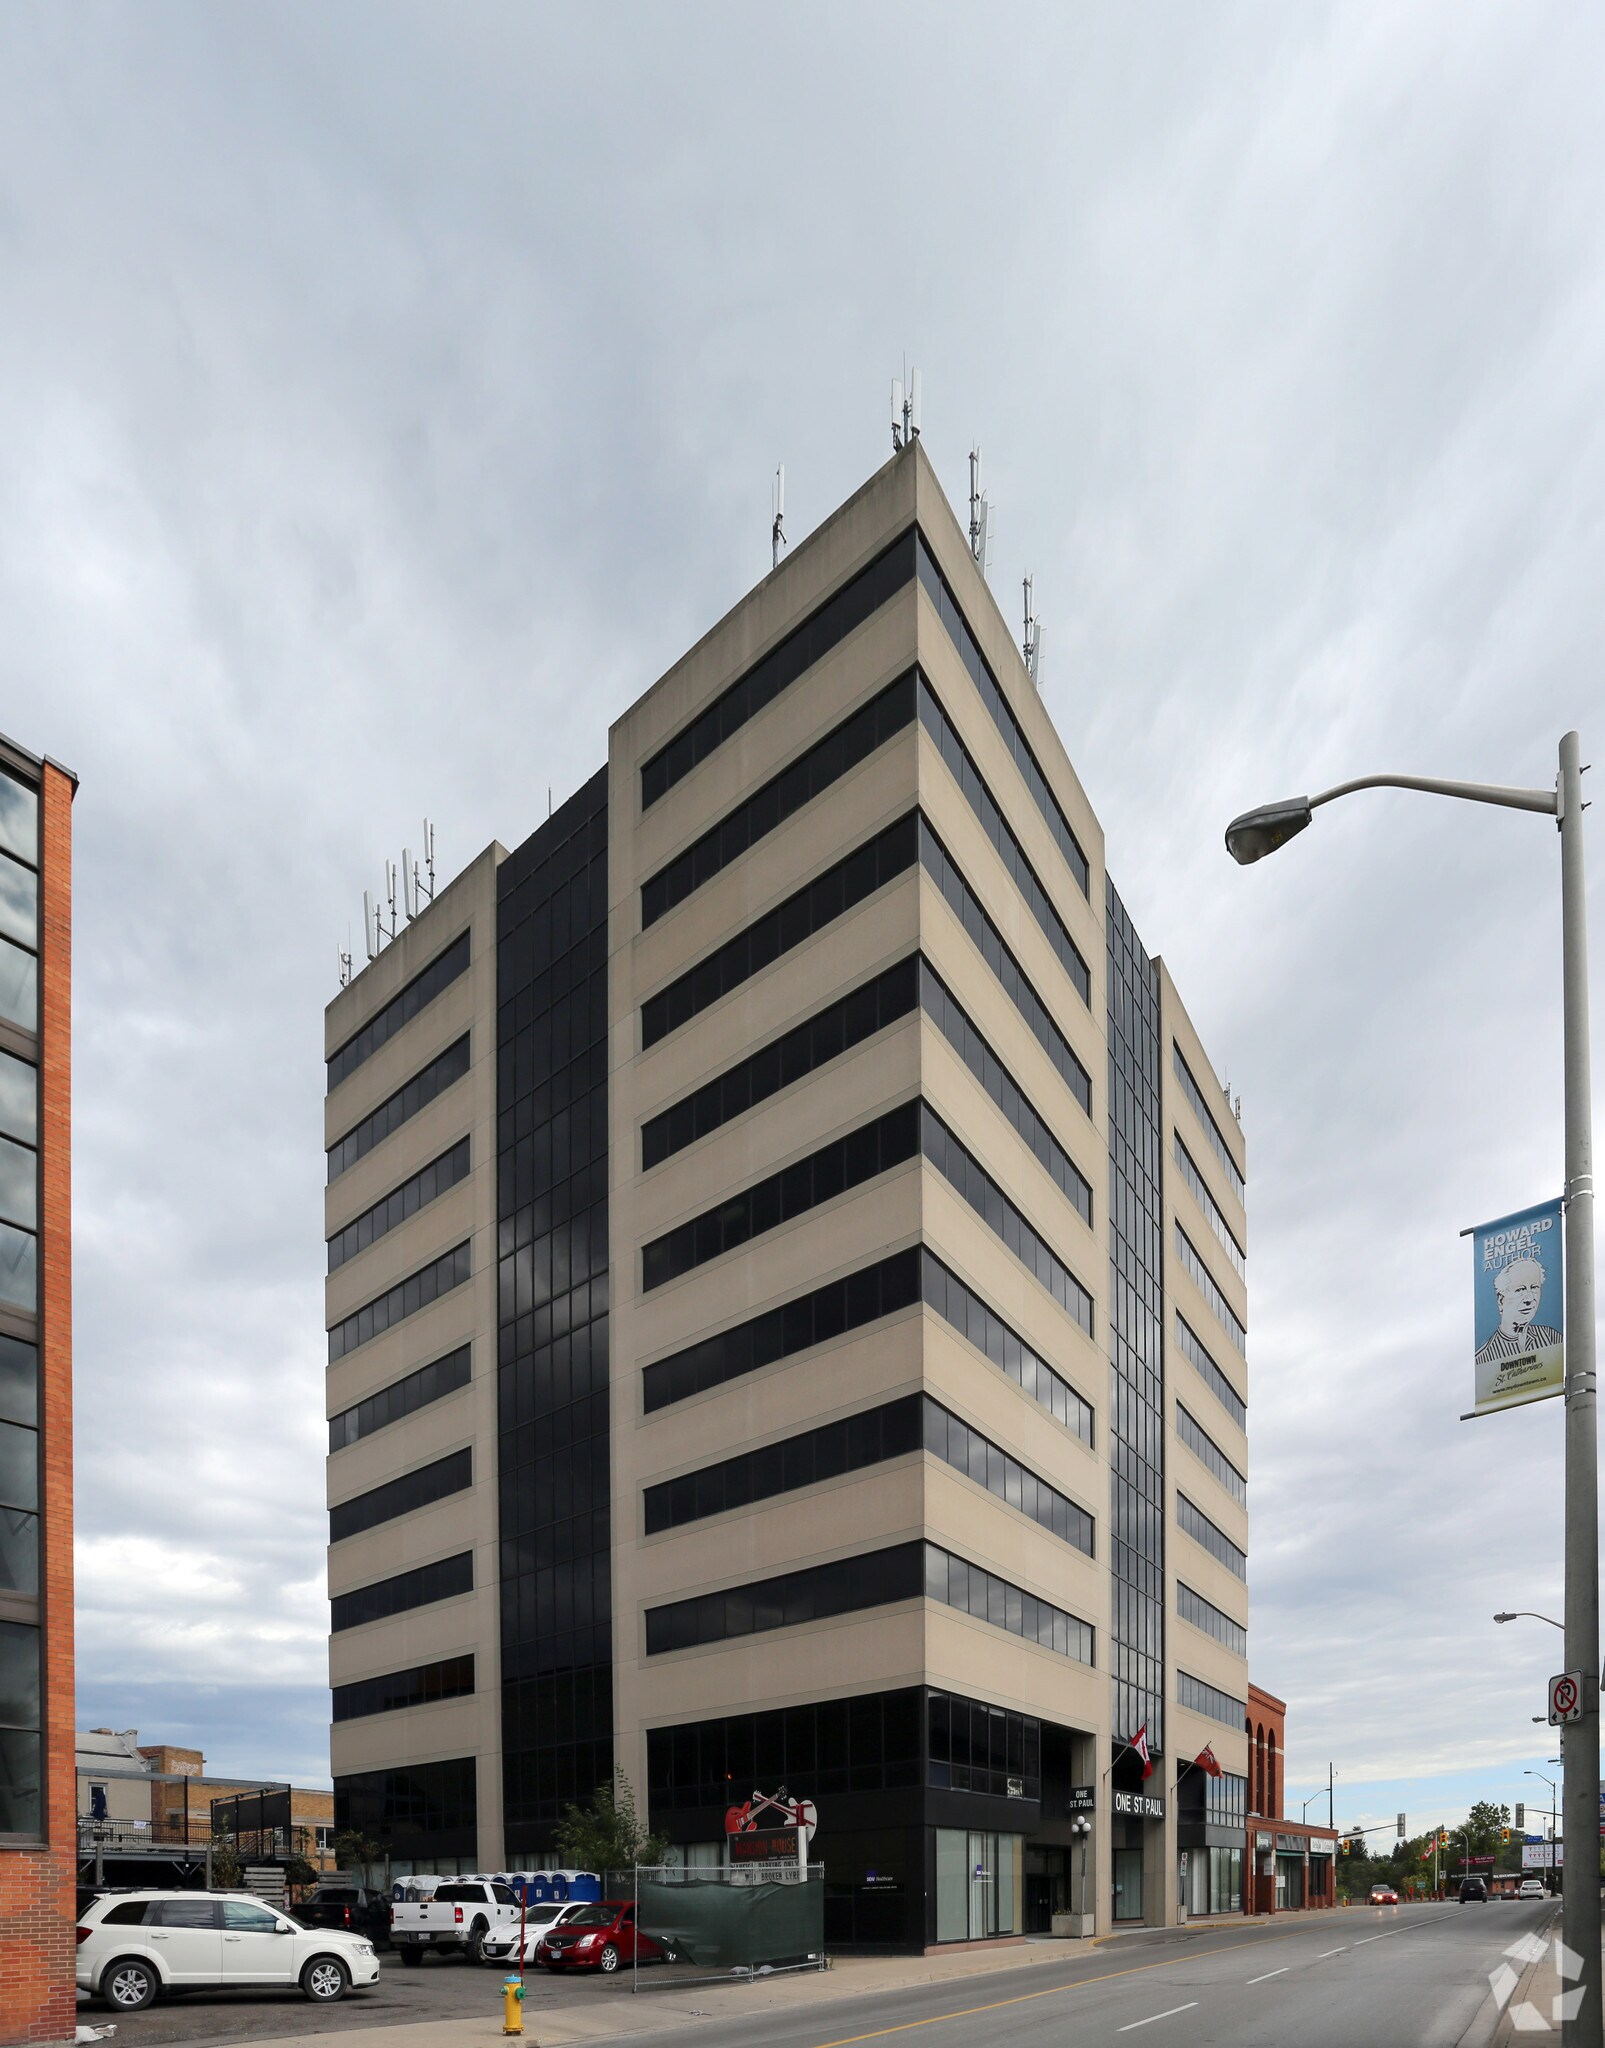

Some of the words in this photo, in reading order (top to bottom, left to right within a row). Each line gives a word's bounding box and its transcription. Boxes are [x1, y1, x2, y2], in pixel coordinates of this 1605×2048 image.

[1484, 1218, 1553, 1250] HOWARD
[1484, 1236, 1537, 1261] ENGEL
[1484, 1245, 1542, 1273] AUTHOR
[1501, 1355, 1536, 1372] DOWNTOWN
[1075, 1790, 1088, 1799] ONE
[1078, 1799, 1094, 1808] PAUL
[1115, 1792, 1131, 1812] ONE
[1133, 1796, 1144, 1814] ST.
[1145, 1798, 1163, 1816] PAUL
[771, 1837, 797, 1855] HOUSE
[761, 1871, 783, 1881] BROKEN
